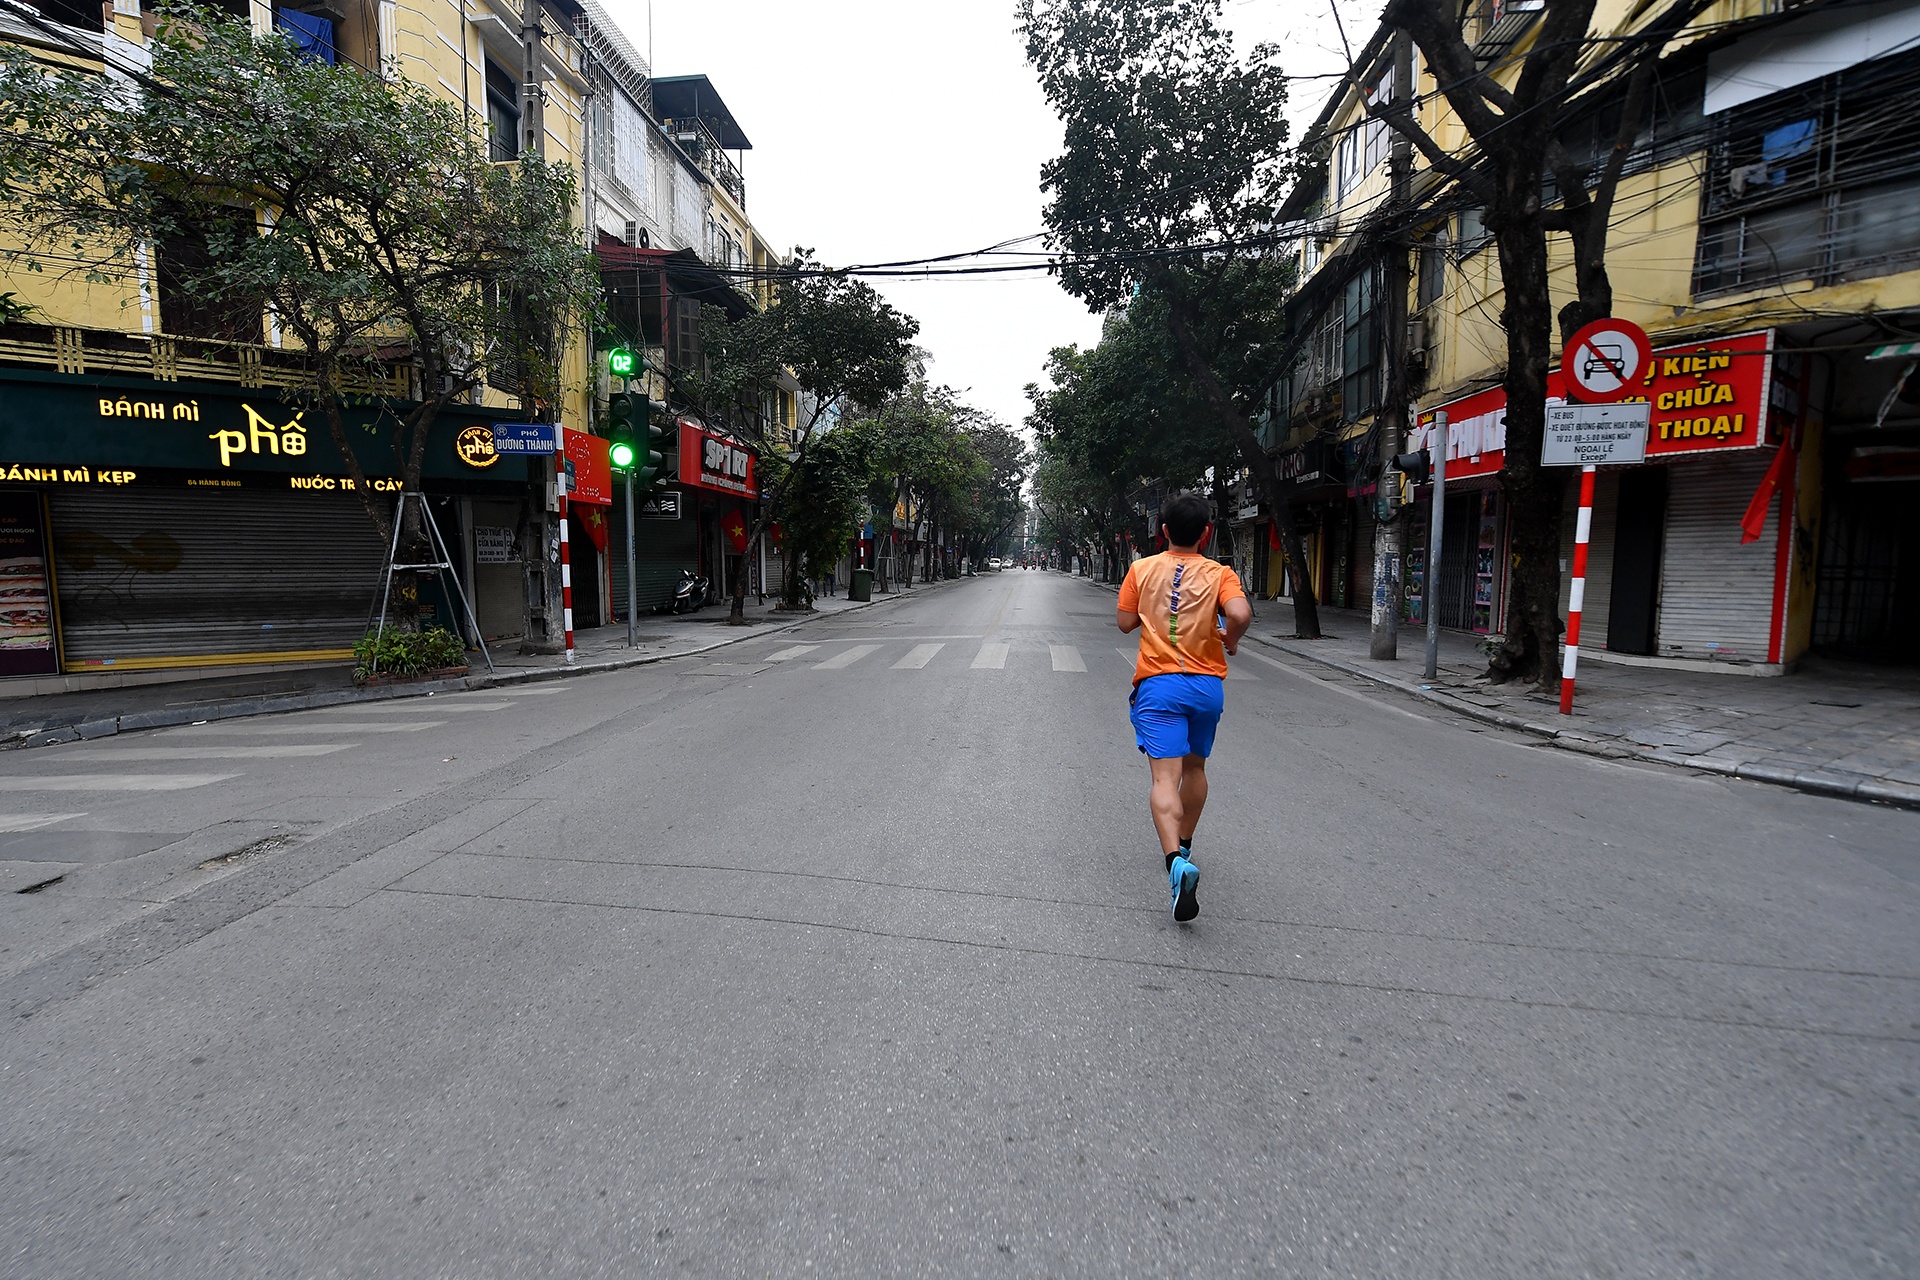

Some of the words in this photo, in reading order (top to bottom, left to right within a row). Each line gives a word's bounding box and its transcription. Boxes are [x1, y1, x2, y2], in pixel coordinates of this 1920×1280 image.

[613, 355, 631, 371] 02
[1663, 347, 1731, 378] KIỆN
[1657, 380, 1734, 411] CHỮA
[99, 395, 165, 420] BÁNH
[172, 399, 200, 422] MÌ
[1562, 411, 1574, 420] BUS
[208, 403, 307, 467] phố
[521, 428, 539, 436] PHỐ
[1657, 414, 1744, 440] THOẠI
[462, 435, 495, 459] phố
[525, 437, 553, 450] THÀNH
[1580, 453, 1607, 462] Except
[0, 464, 58, 482] BÁNH
[63, 466, 90, 483] MÌ
[97, 470, 137, 486] KẸP
[290, 474, 336, 490] NƯỚC
[374, 477, 404, 491] CÂY
